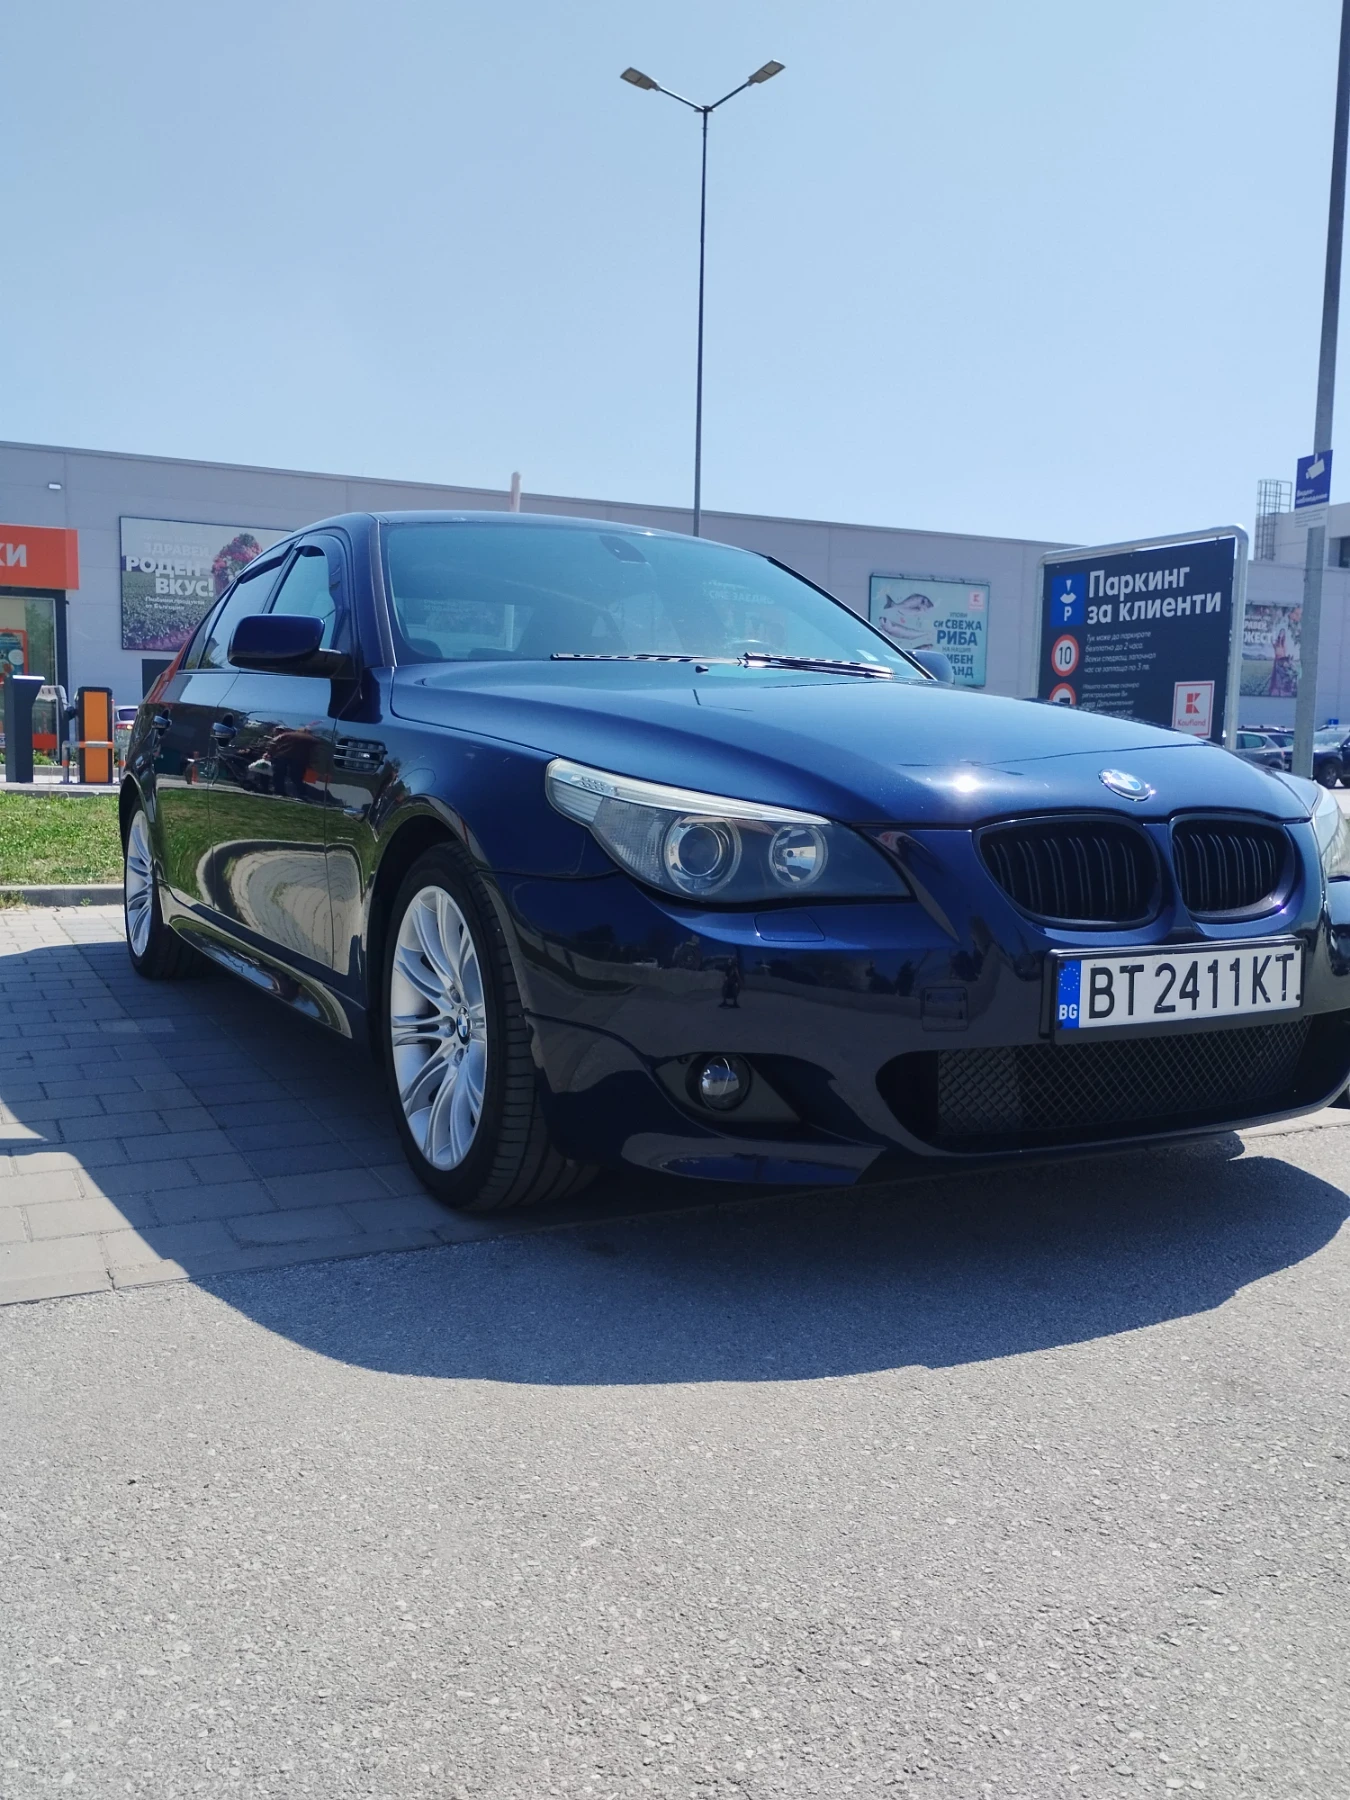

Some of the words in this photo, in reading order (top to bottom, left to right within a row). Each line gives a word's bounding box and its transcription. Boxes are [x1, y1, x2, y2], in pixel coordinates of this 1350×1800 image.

[125, 555, 201, 578] РОДЕН
[155, 578, 214, 598] ВКУС!
[1088, 566, 1190, 601] Паркинг
[1087, 602, 1112, 625] за
[1119, 591, 1221, 622] клиенти
[945, 619, 982, 631] СВЕЖА
[937, 630, 978, 646] РИБА
[1124, 642, 1128, 650] 2
[946, 654, 974, 665] ИБЕН
[1058, 646, 1072, 665] 10
[952, 666, 974, 678] АНД
[1177, 718, 1206, 727] Kaufland
[1058, 1004, 1077, 1020] BG
